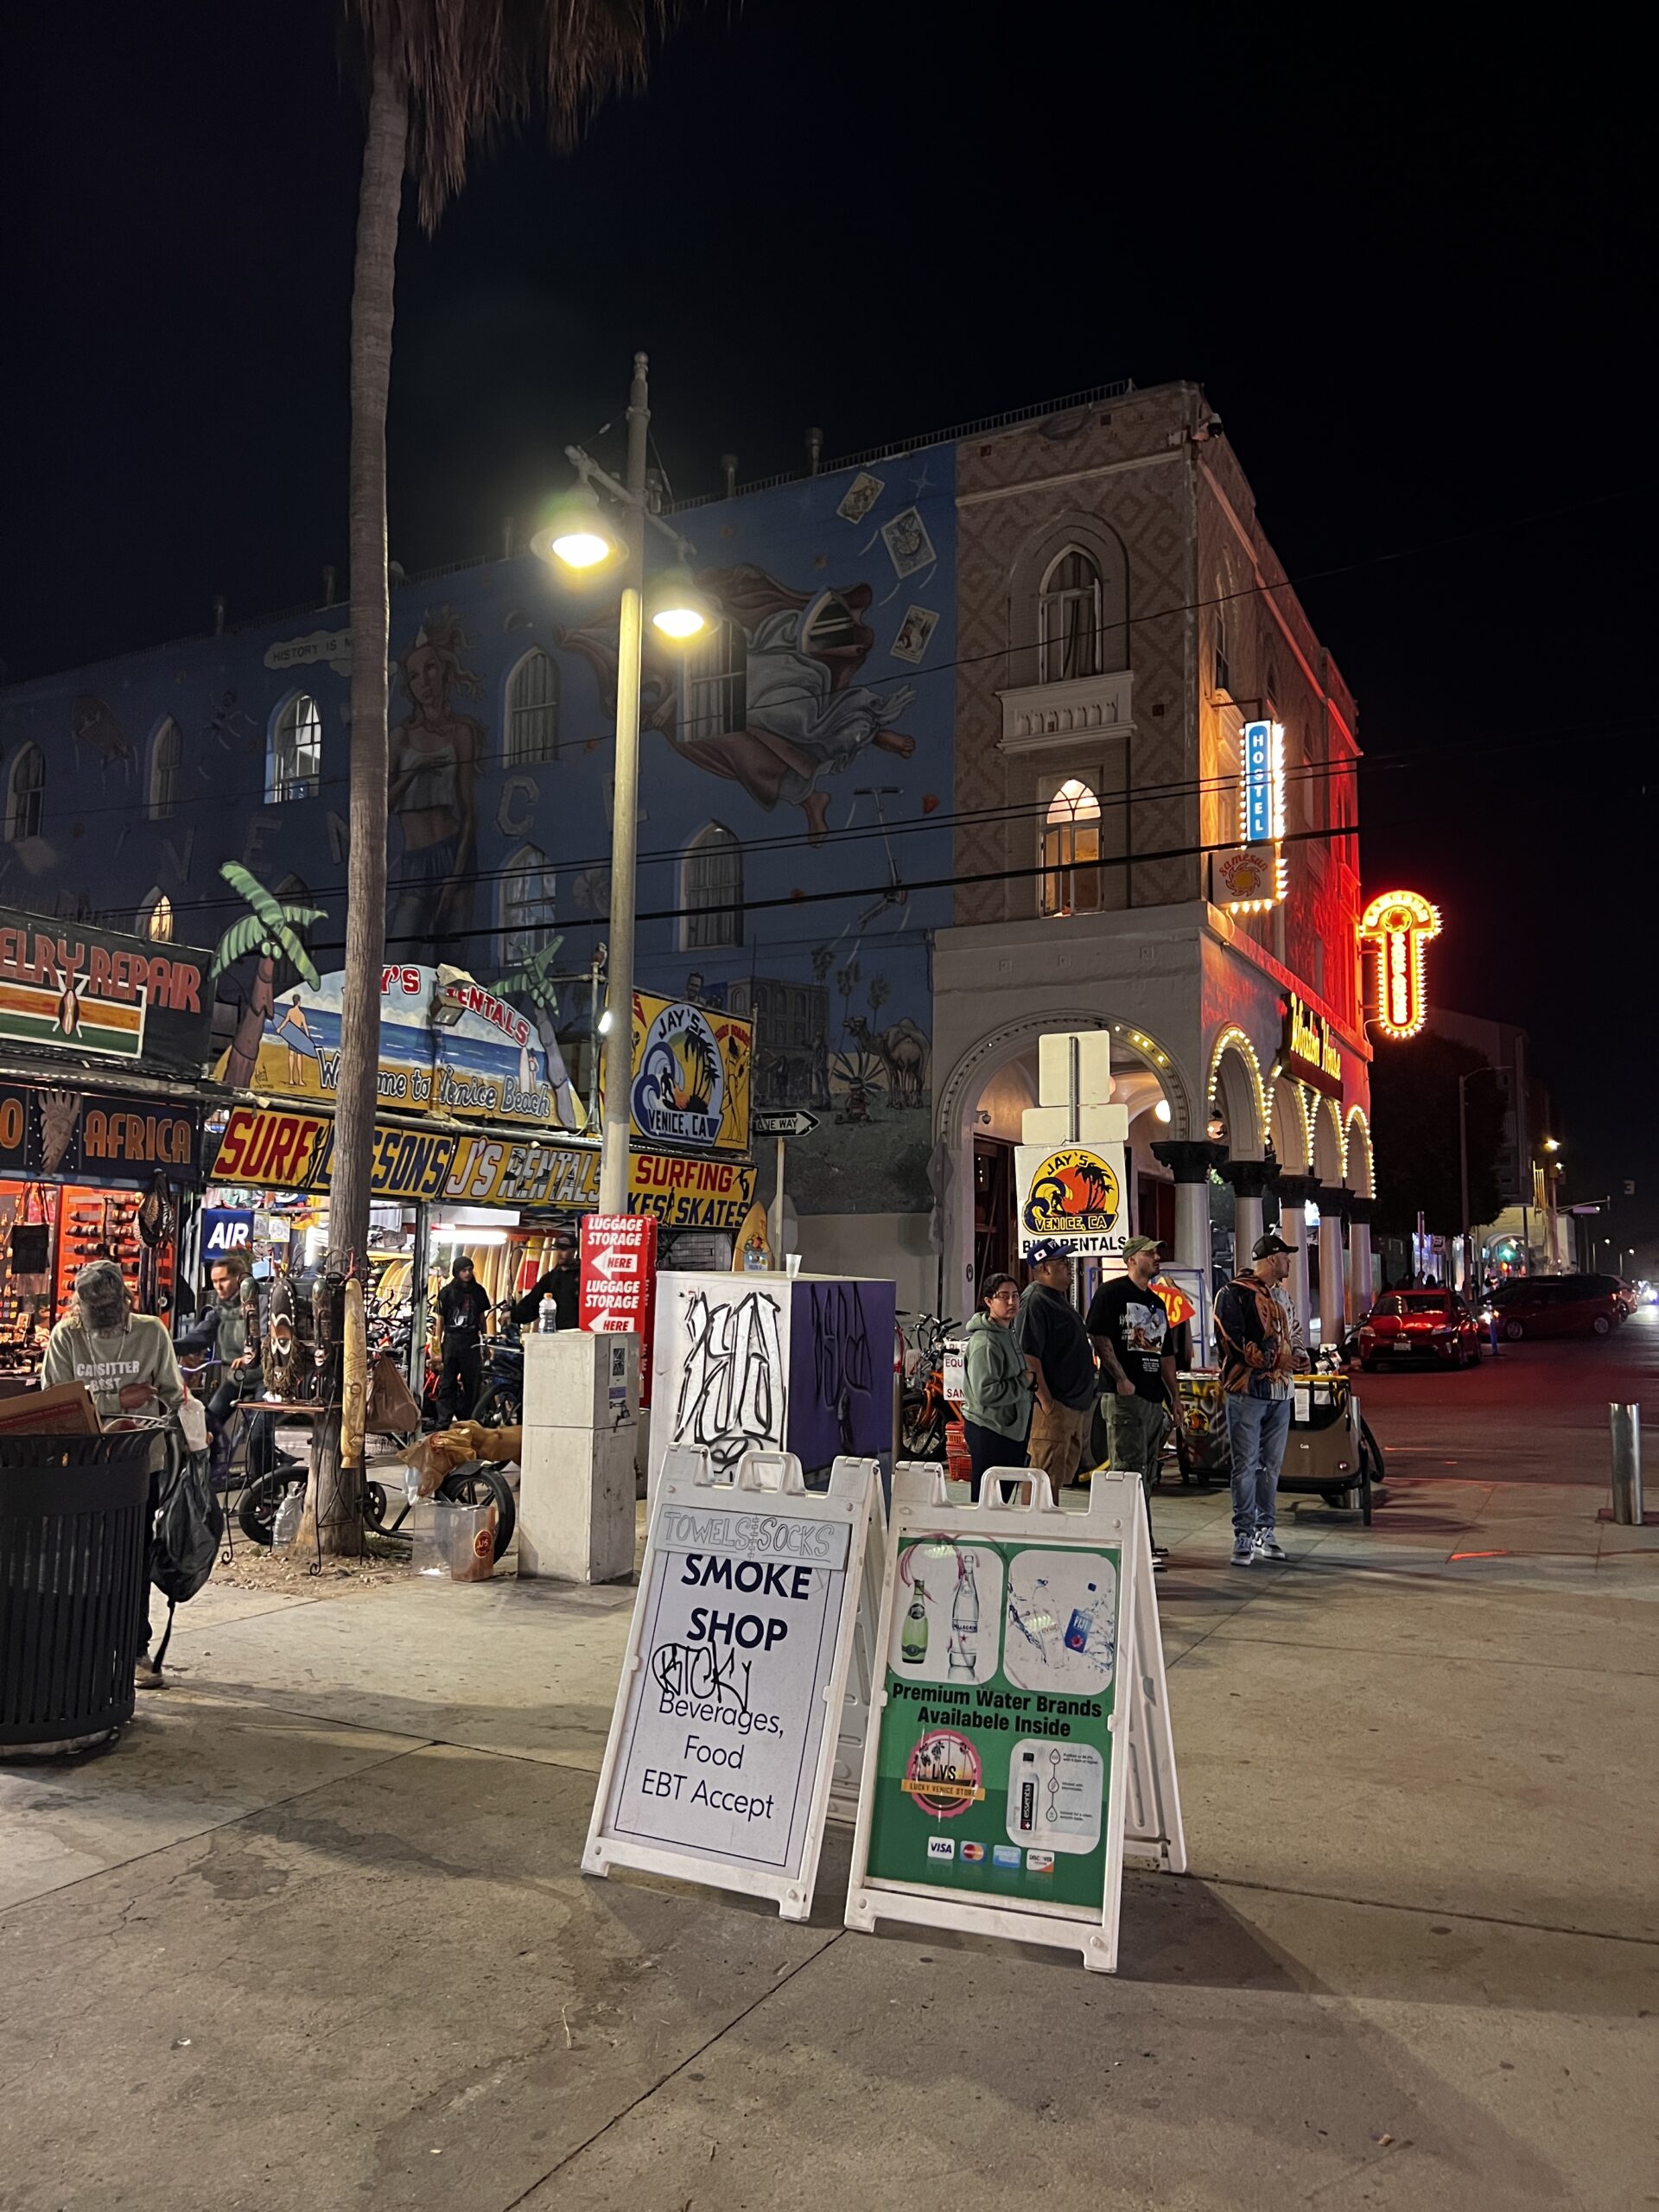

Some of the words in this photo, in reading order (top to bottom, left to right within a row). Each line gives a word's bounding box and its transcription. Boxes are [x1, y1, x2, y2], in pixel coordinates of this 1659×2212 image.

[273, 645, 319, 662] HISTORY
[327, 640, 337, 652] IS
[1253, 734, 1264, 831] HOSTEL
[1219, 854, 1268, 877] samesun
[89, 945, 200, 1014] REPAIR
[658, 1009, 701, 1039] JAY'S
[410, 1068, 431, 1100] to
[439, 1065, 496, 1109] Venice
[500, 1075, 549, 1117] Beach
[84, 1109, 191, 1164] AFRICA
[693, 1116, 709, 1136] CA
[779, 1118, 798, 1128] WAY
[214, 1111, 319, 1181] SURF
[635, 1155, 734, 1192] SURFING
[1047, 1152, 1089, 1176] JAY'S
[588, 1217, 644, 1232] LUGGAGE
[675, 1196, 751, 1228] SKATES
[1034, 1215, 1086, 1231] VENICE,
[1089, 1214, 1107, 1229] CA
[207, 1222, 250, 1249] AIR
[588, 1232, 643, 1246] STORAGE
[607, 1257, 632, 1268] HERE
[584, 1294, 639, 1309] STORAGE
[586, 1281, 640, 1294] LUGGAGE
[602, 1320, 629, 1332] HERE
[664, 1511, 750, 1553] TOWELS
[756, 1516, 835, 1557] SOCKS
[681, 1554, 812, 1600] SMOKE
[686, 1607, 789, 1651] SHOP
[658, 1689, 784, 1738] Beverages,
[893, 1682, 969, 1700] Premium
[976, 1689, 1031, 1711] Water
[1037, 1695, 1103, 1718] Brands
[918, 1707, 1009, 1731] Availabele
[1014, 1714, 1071, 1738] Inside
[683, 1734, 745, 1770] Food
[931, 1763, 957, 1781] LVS
[641, 1769, 688, 1801] EBT
[690, 1779, 775, 1822] Accept
[910, 1783, 931, 1793] LUCKY
[932, 1785, 954, 1796] VENICE
[956, 1787, 976, 1797] STORE
[931, 1842, 952, 1853] VISA
